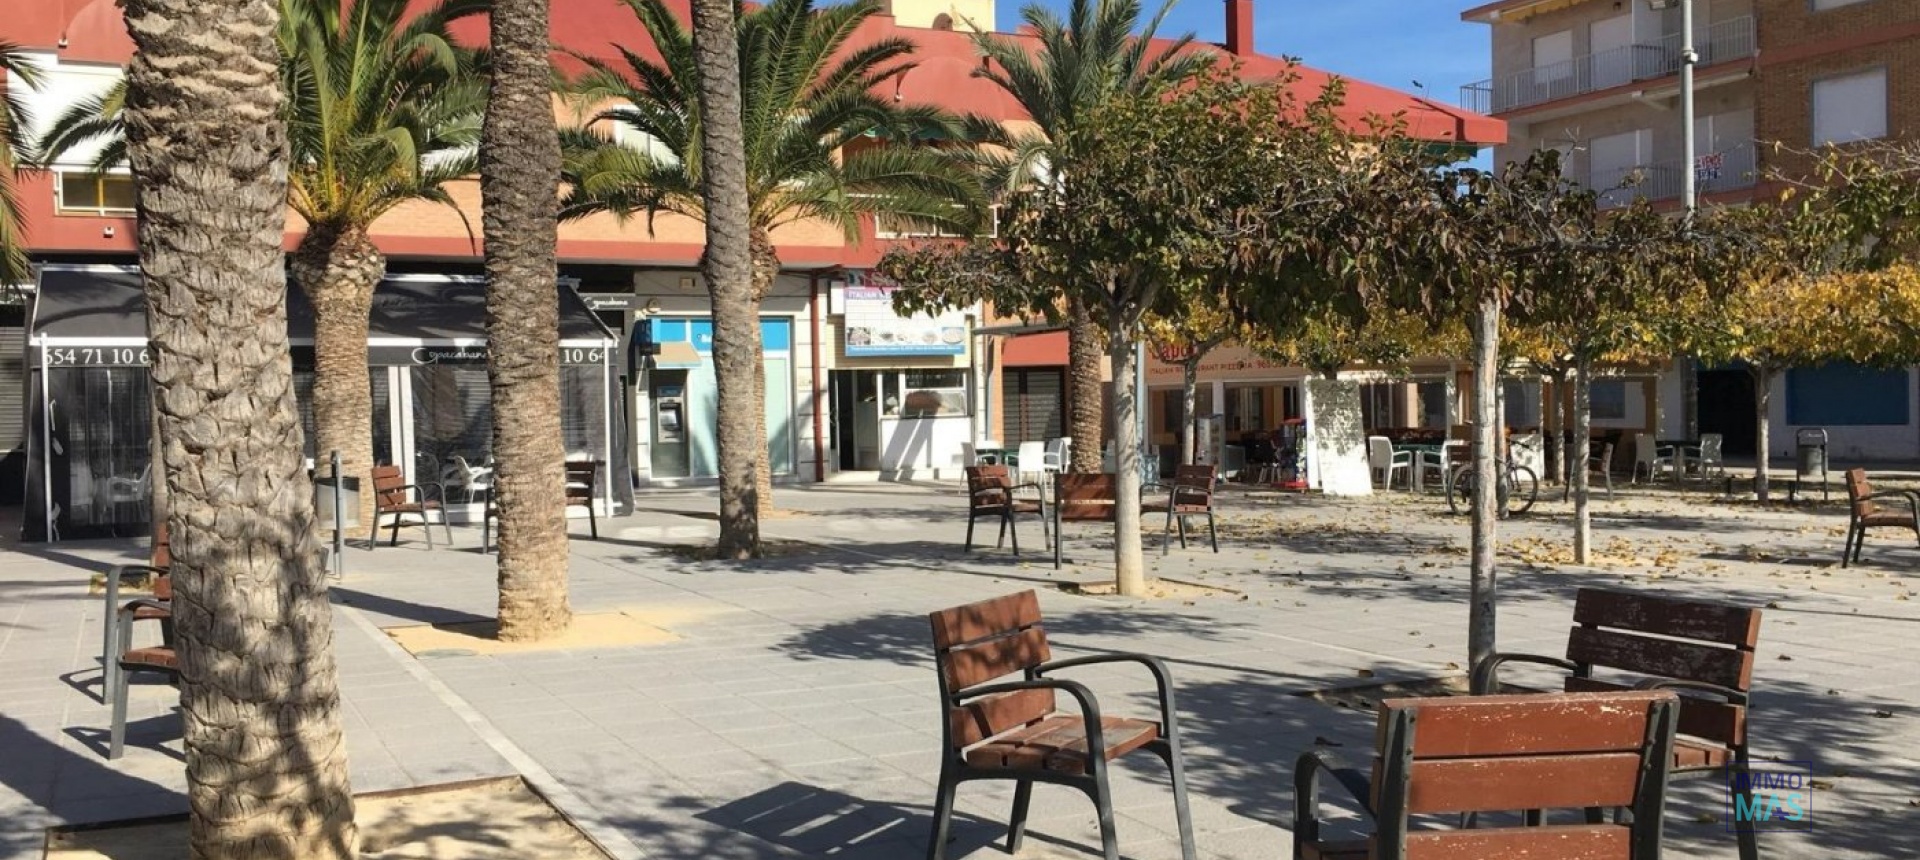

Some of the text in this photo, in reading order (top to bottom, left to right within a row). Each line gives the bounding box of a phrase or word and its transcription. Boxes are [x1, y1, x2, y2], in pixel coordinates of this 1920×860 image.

[81, 348, 103, 364] 71
[112, 348, 134, 364] 10
[139, 348, 149, 364] 6
[563, 348, 584, 363] 10
